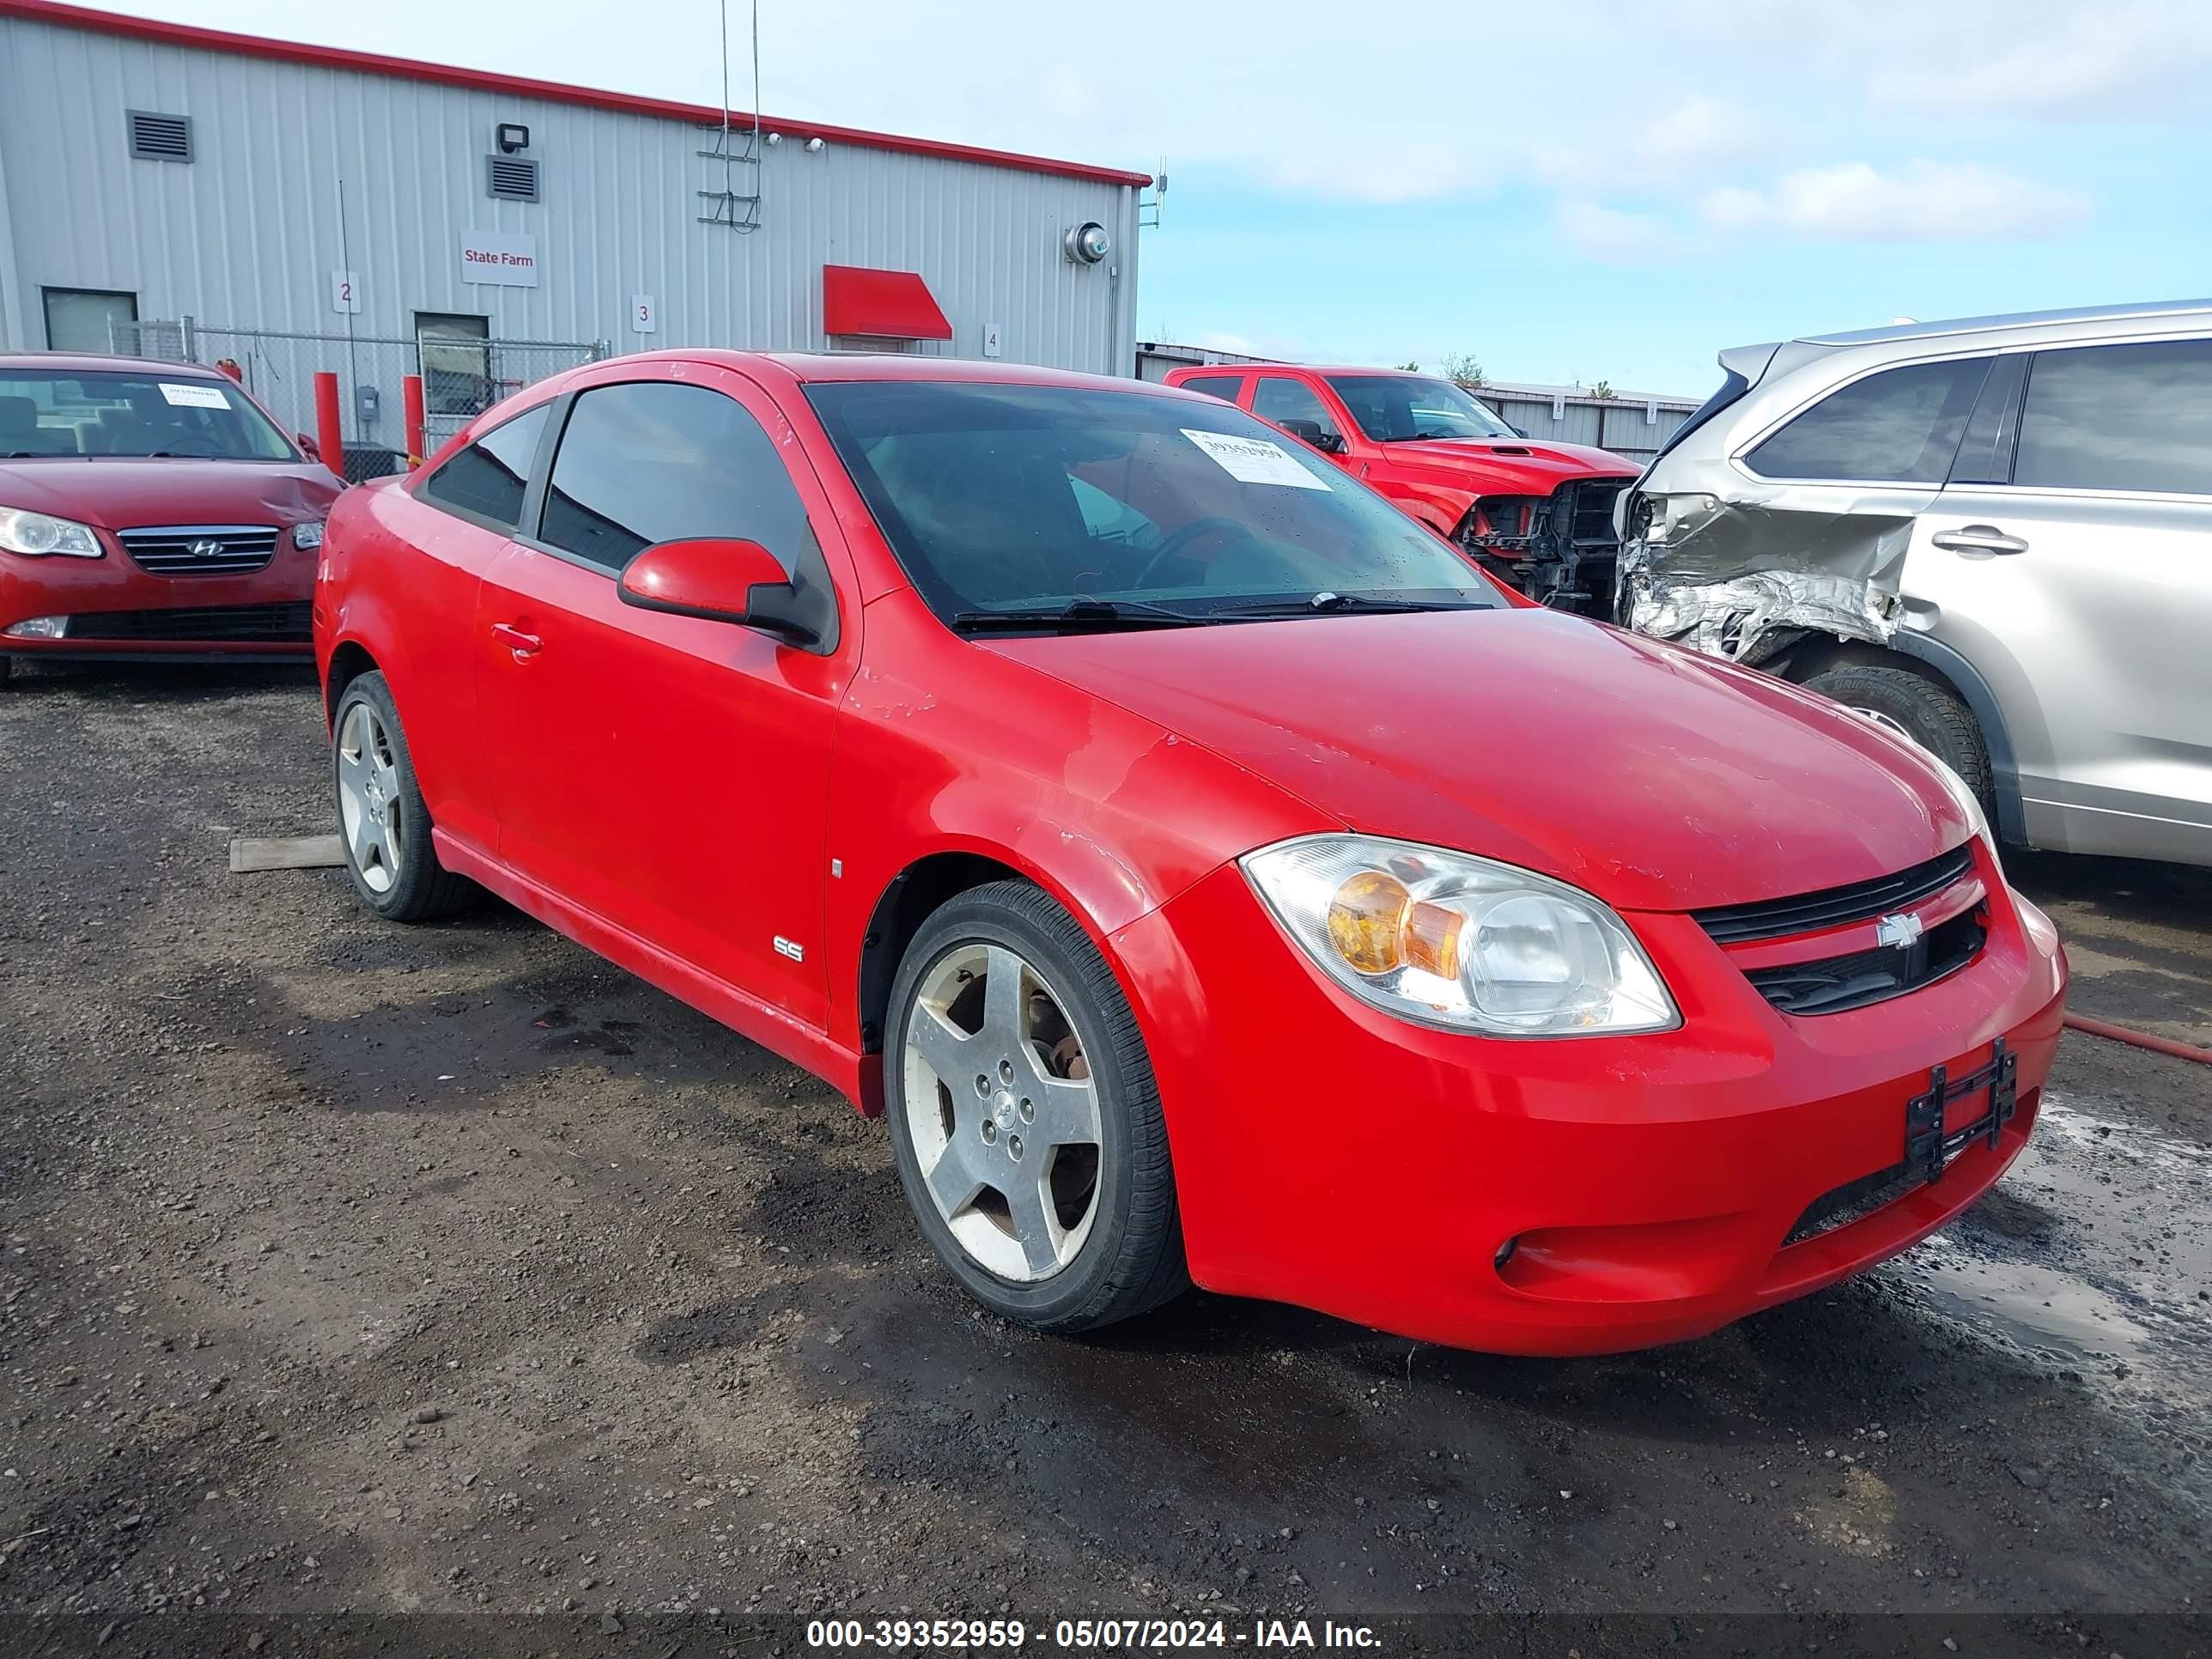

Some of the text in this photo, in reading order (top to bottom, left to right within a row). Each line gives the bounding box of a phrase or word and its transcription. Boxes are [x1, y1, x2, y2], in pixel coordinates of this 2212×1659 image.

[465, 249, 533, 266] State Farm
[341, 283, 352, 301] 2
[639, 305, 648, 321] 3
[989, 333, 996, 347] 4
[1650, 408, 1655, 417] 9
[1204, 441, 1282, 459] 39352959
[774, 935, 803, 962] SS
